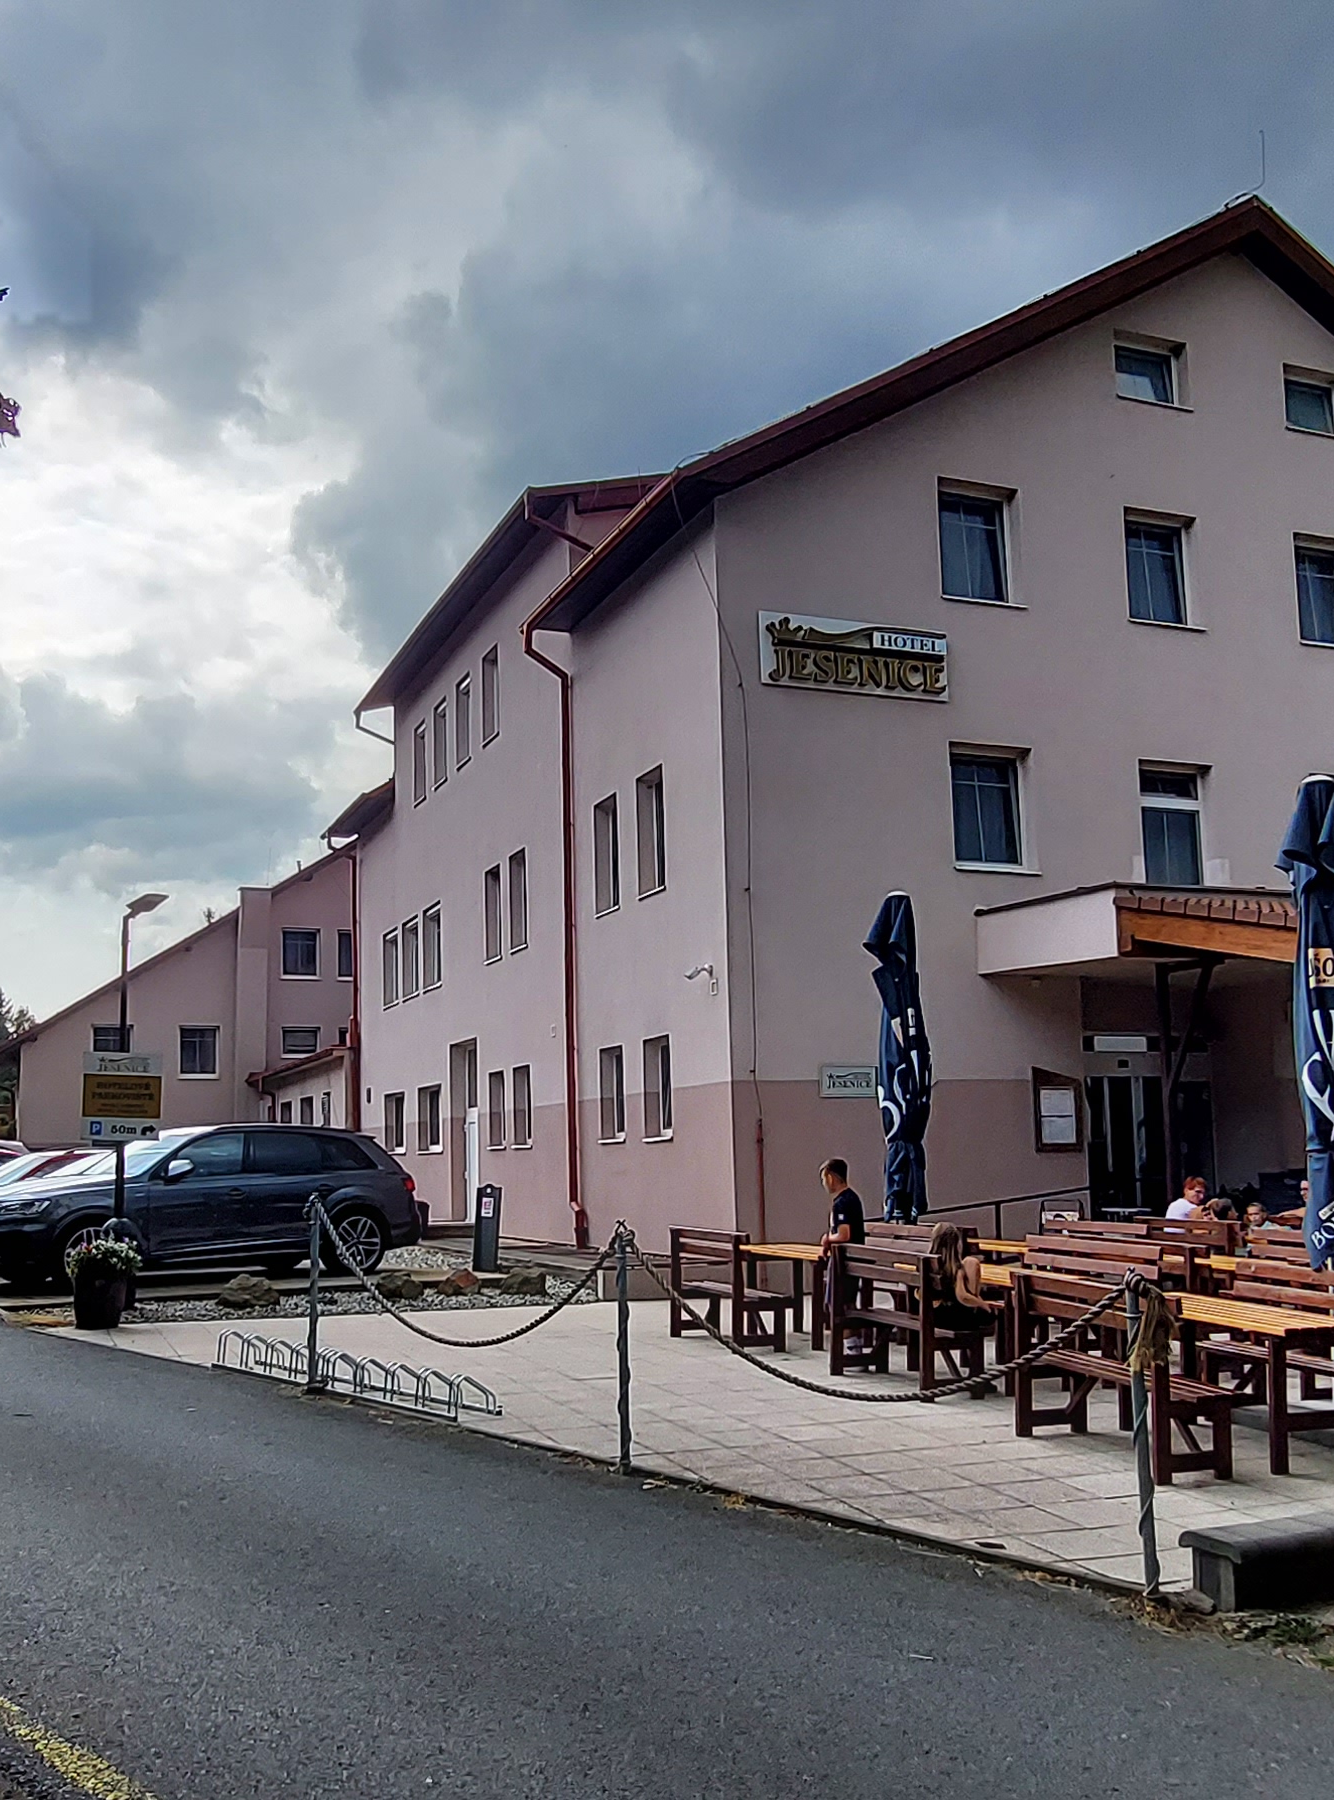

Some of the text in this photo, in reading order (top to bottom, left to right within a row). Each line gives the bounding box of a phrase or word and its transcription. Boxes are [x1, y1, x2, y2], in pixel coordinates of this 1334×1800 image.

[879, 633, 942, 653] HOTEL
[768, 648, 947, 694] JESENICE
[827, 1079, 872, 1089] JESENICE
[92, 1123, 101, 1134] P
